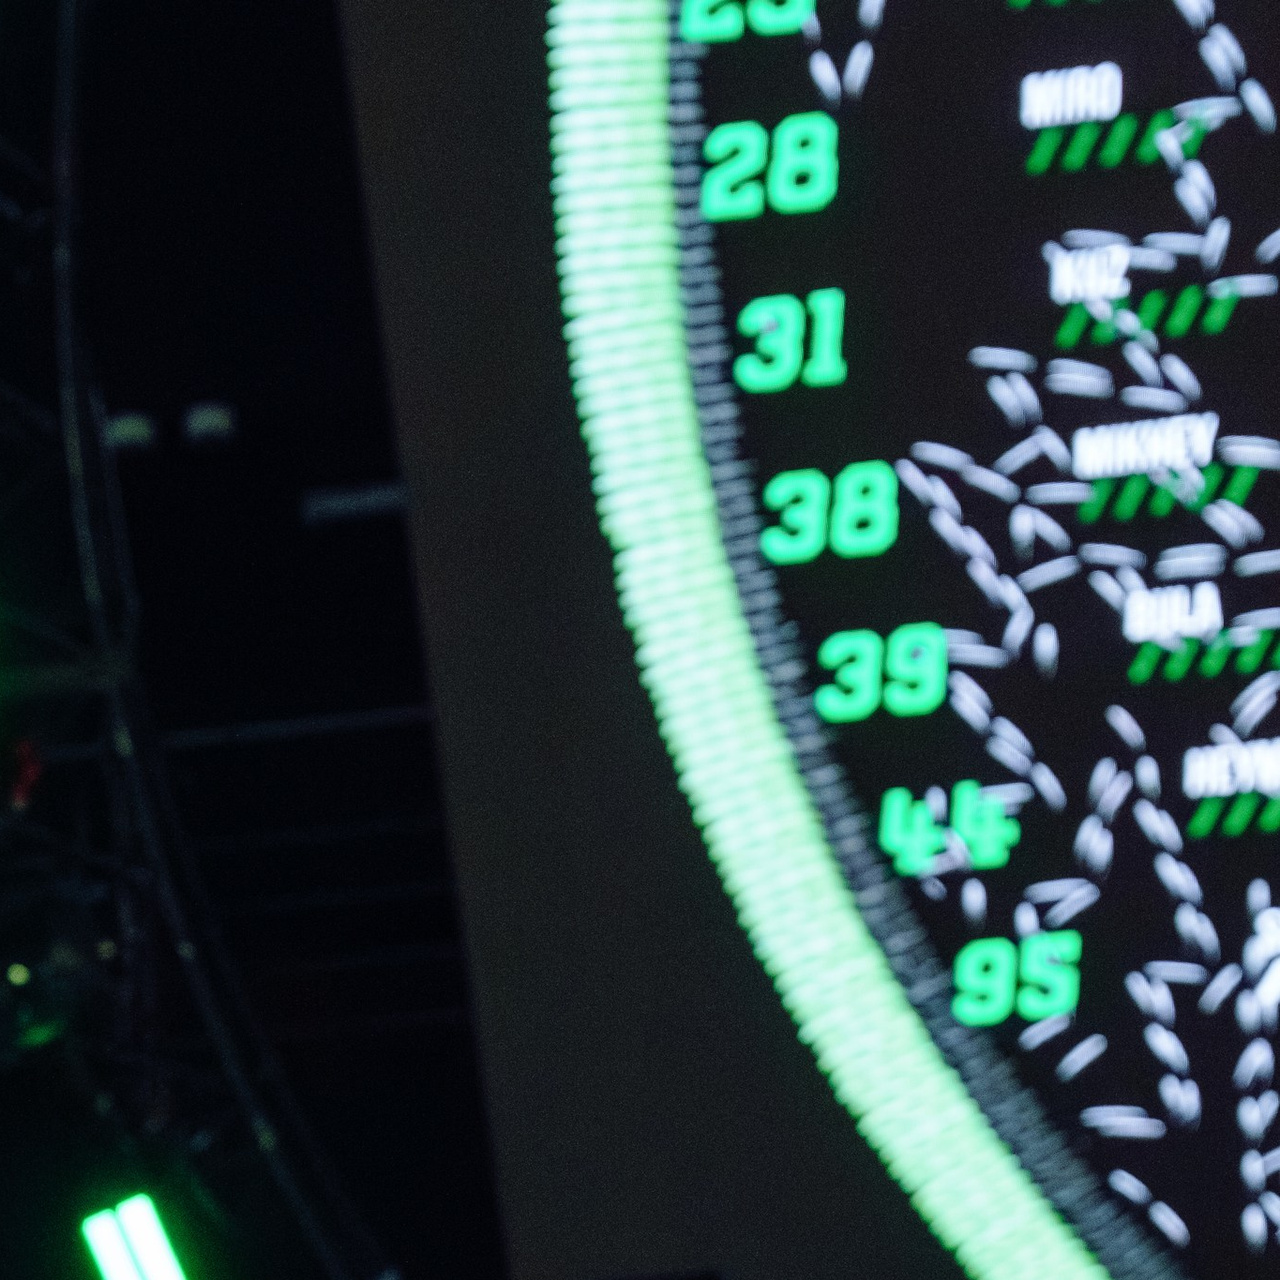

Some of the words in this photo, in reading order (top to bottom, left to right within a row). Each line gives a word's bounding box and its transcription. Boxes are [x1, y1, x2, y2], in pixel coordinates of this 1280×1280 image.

[699, 111, 839, 222] 28
[733, 287, 847, 393] 31
[759, 459, 899, 565] 38
[814, 621, 949, 723] 39
[879, 779, 1022, 877] 44
[951, 929, 1083, 1027] 95
